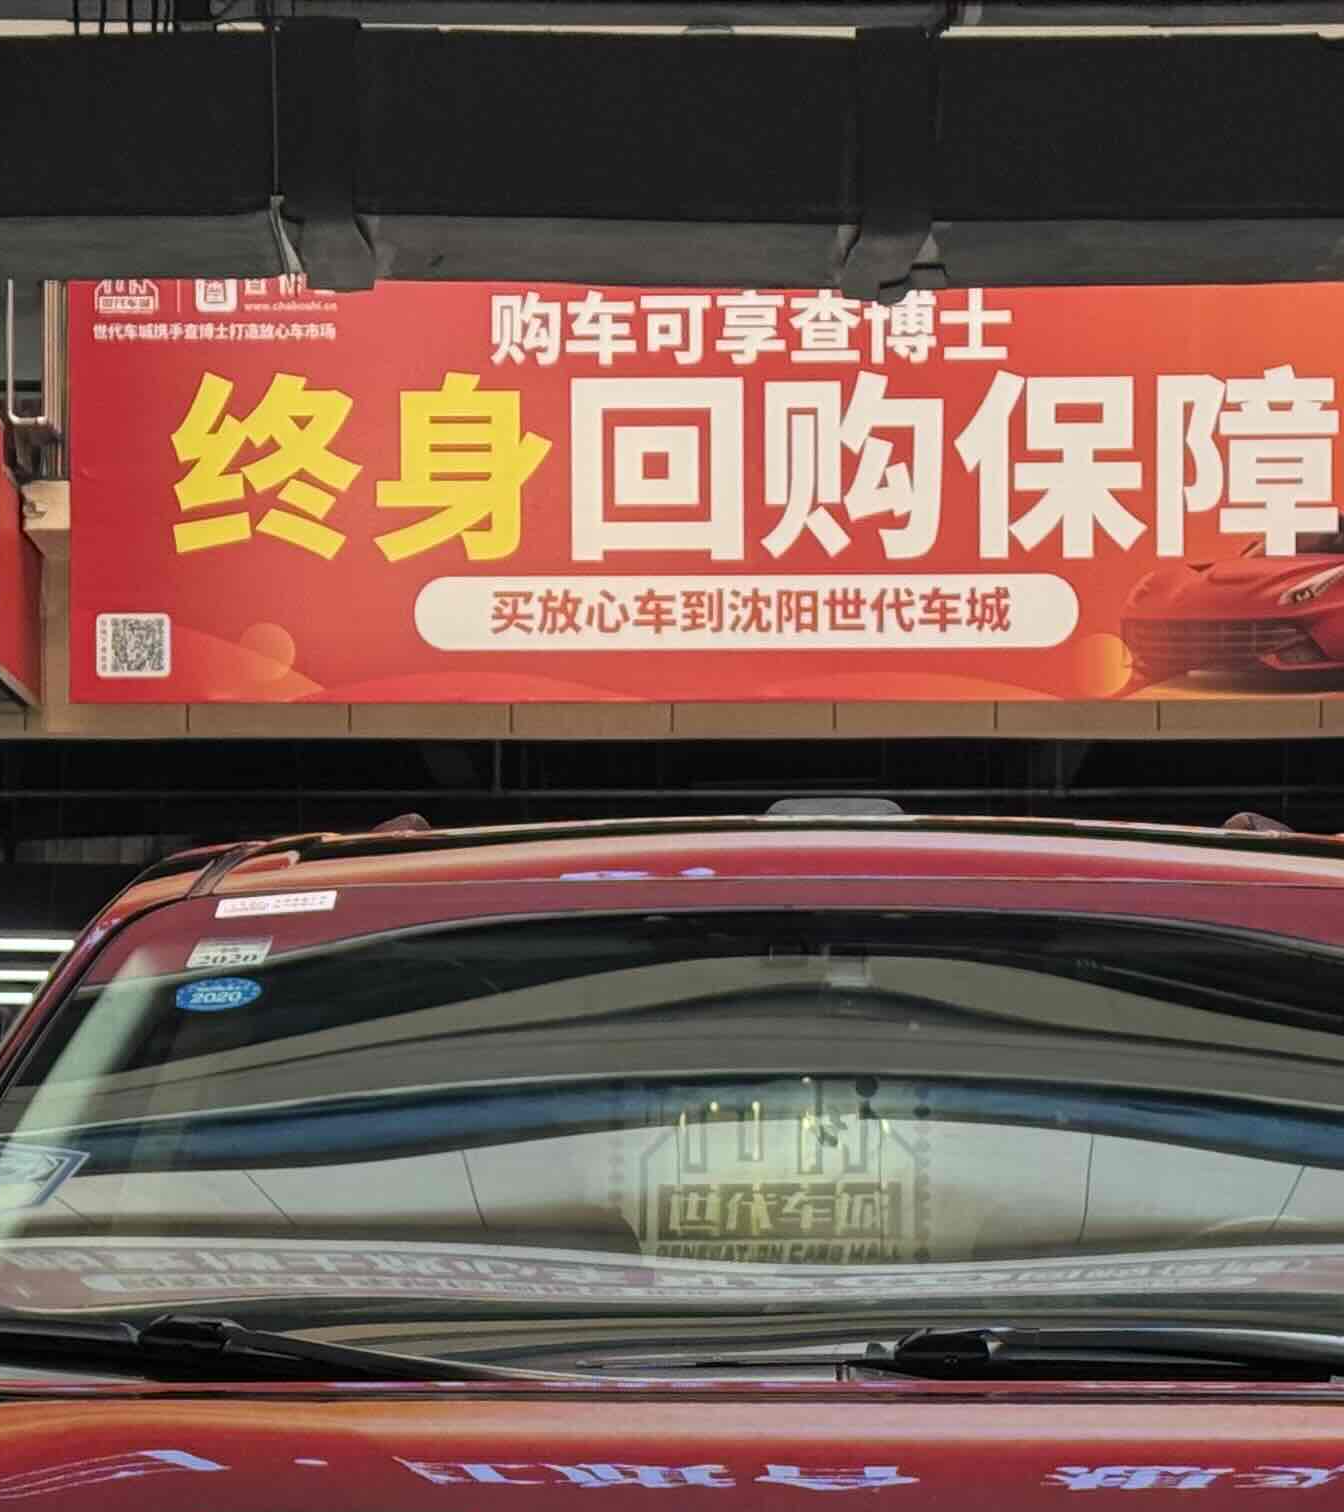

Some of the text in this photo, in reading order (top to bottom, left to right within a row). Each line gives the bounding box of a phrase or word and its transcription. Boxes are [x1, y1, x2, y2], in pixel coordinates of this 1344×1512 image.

[490, 288, 1012, 366] 购车可享查博士
[171, 367, 1340, 562] 终身回购保障
[490, 587, 1011, 634] 买放心车到沈阳世代车城
[191, 990, 243, 1004] 2020
